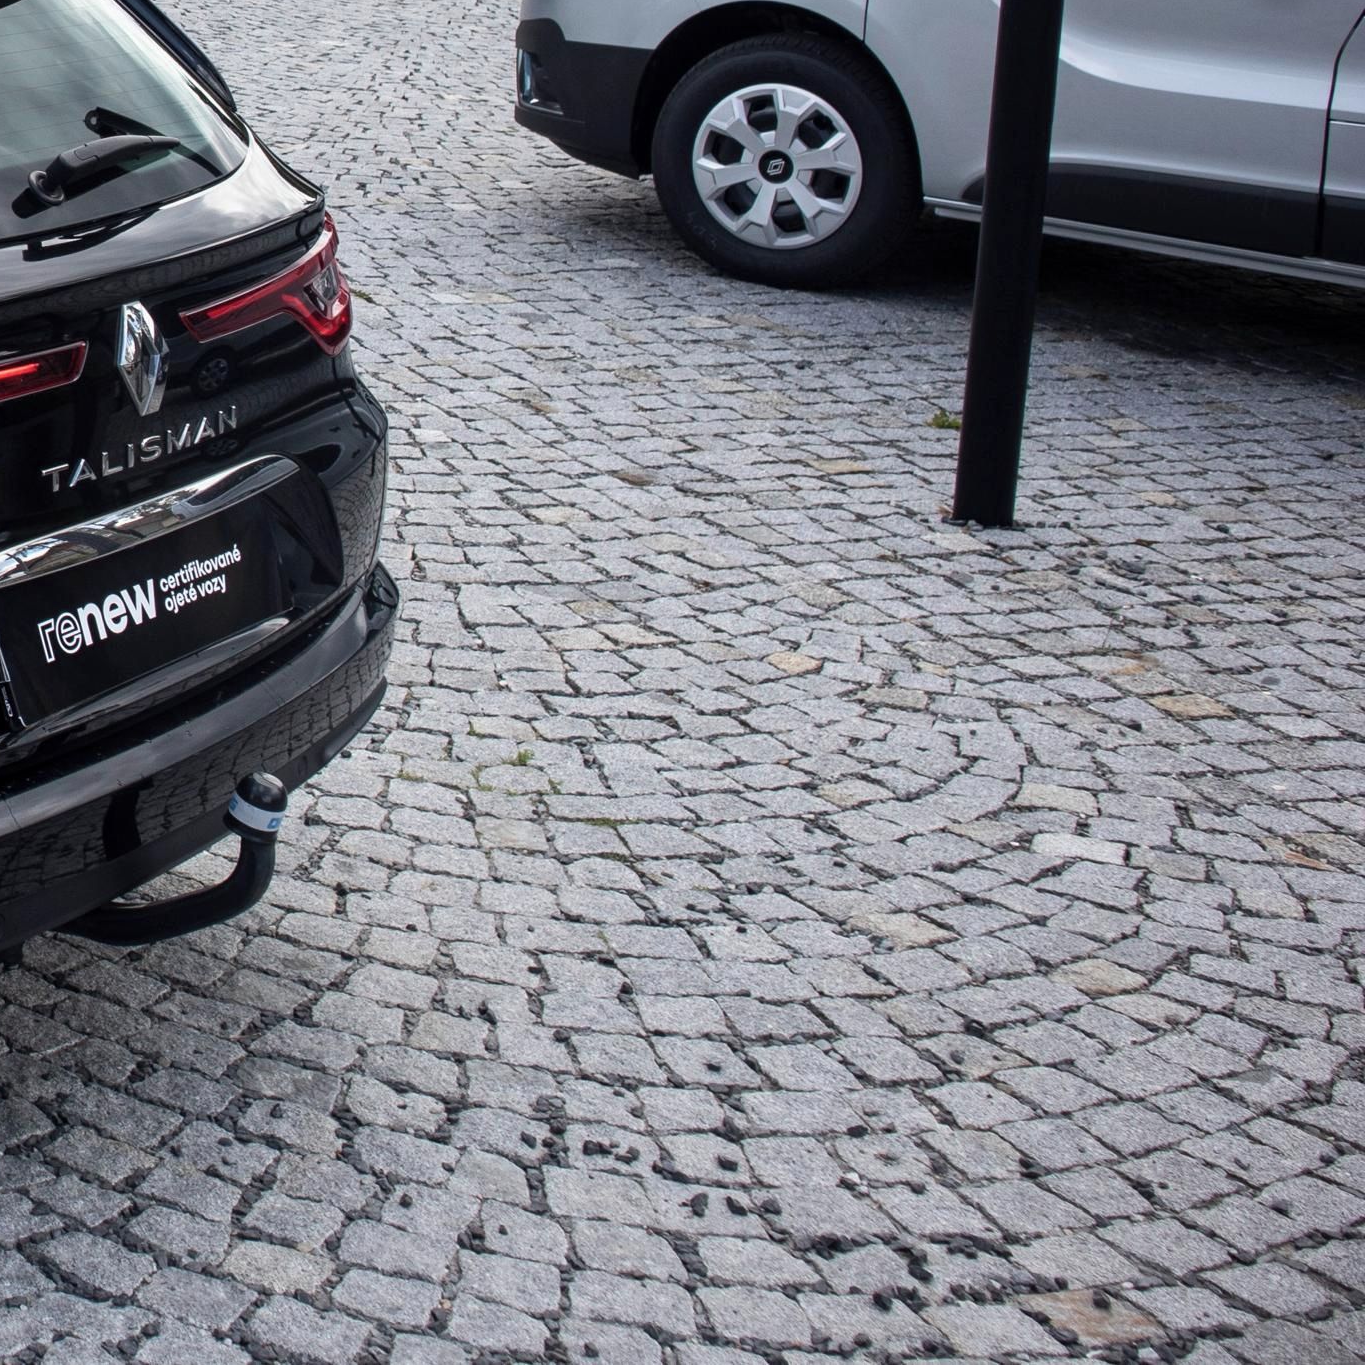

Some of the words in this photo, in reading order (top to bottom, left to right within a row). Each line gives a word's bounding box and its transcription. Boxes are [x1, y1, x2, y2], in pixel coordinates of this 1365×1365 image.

[41, 405, 238, 492] TALISMAN
[159, 543, 242, 592] certifikované
[164, 583, 198, 614] ojeté
[198, 573, 227, 599] vozy
[37, 579, 157, 663] renew
